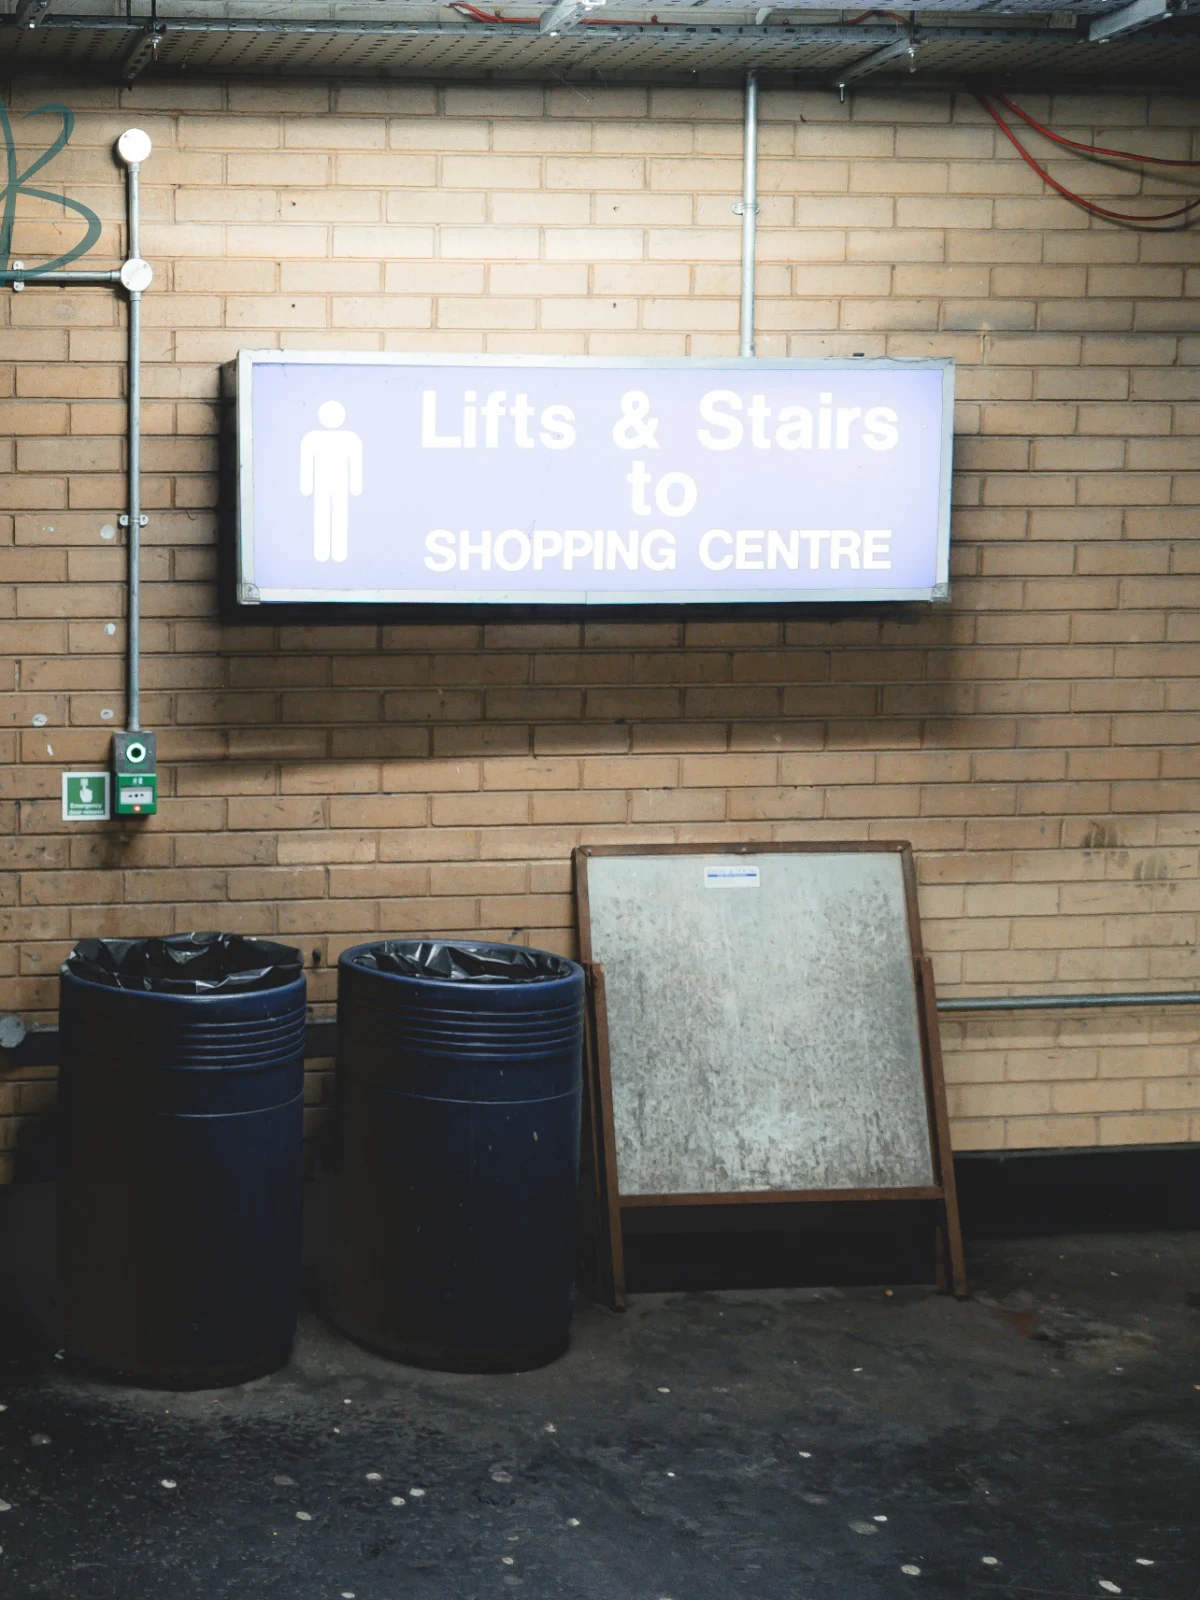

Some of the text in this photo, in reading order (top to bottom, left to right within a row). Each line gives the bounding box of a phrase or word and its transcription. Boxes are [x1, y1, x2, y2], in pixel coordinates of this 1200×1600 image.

[421, 390, 900, 451] Lifts & Stairs
[627, 461, 698, 517] to
[424, 529, 892, 572] SHOPPING CENTRE
